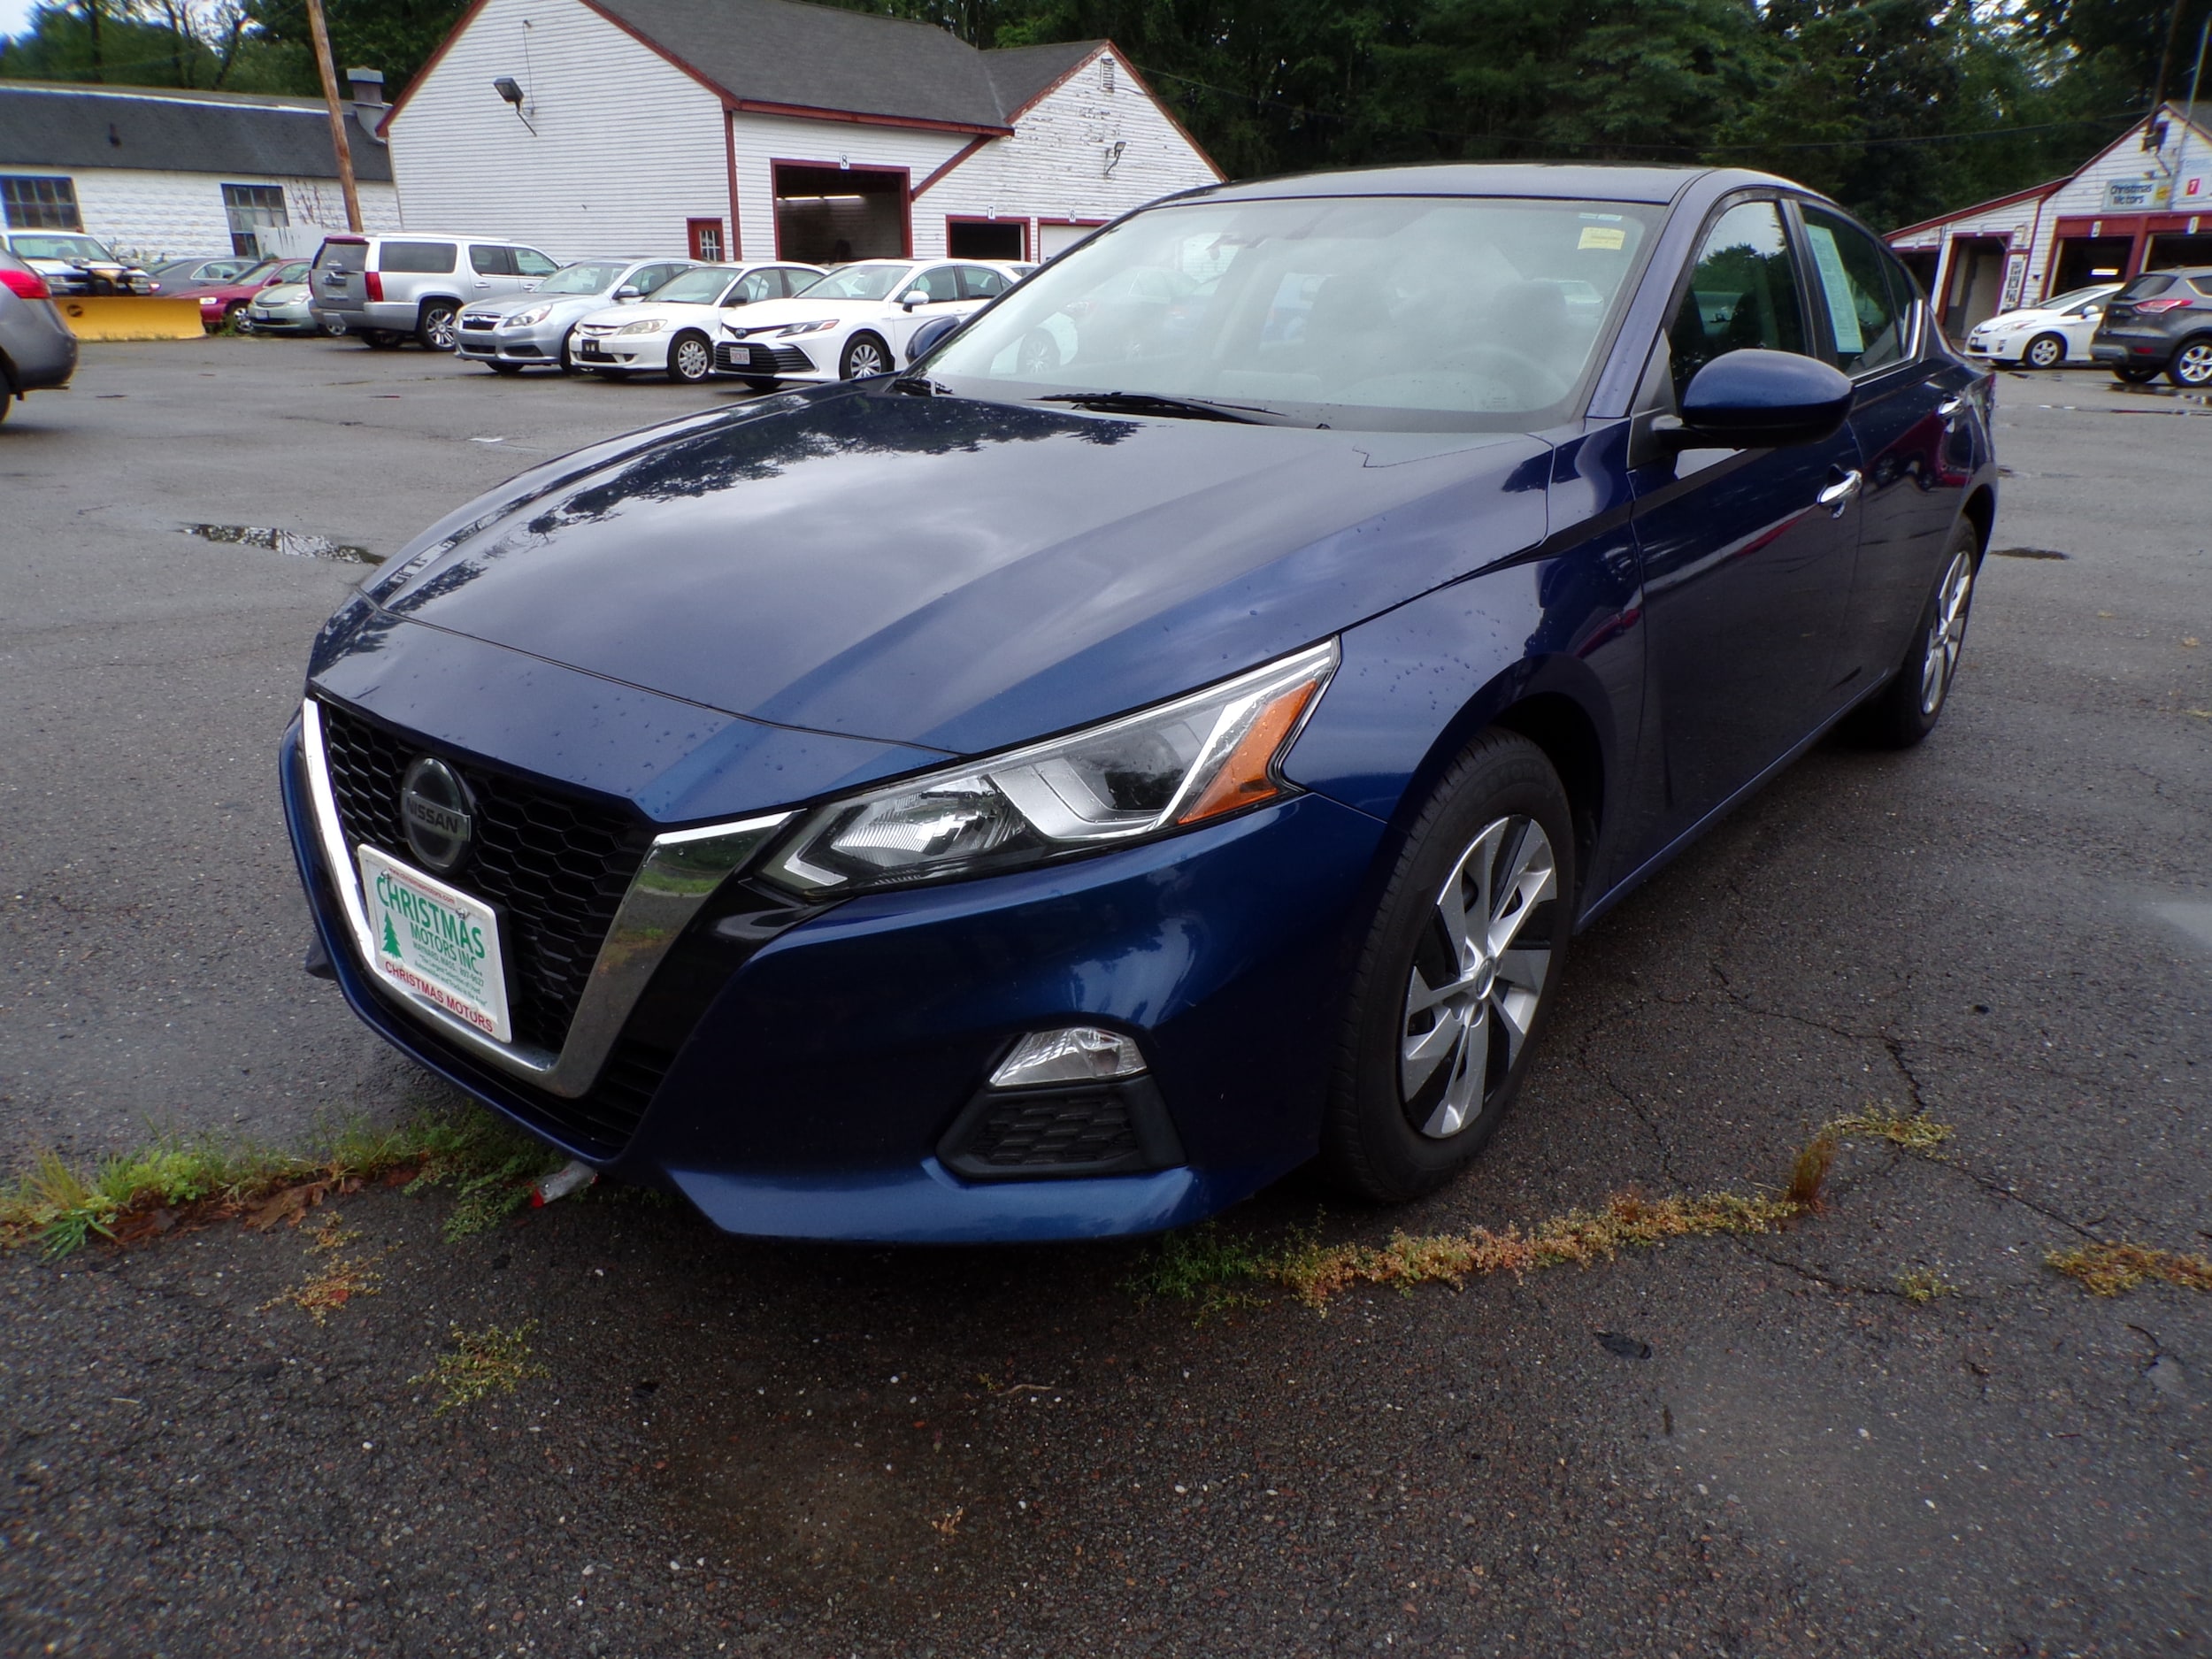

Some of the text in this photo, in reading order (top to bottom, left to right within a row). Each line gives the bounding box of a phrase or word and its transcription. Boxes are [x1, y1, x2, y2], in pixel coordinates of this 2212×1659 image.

[841, 154, 849, 167] 8
[987, 206, 995, 218] 7
[1069, 210, 1075, 220] 6
[406, 795, 458, 834] NISSAN
[375, 875, 485, 959] CHRISTMAS
[410, 922, 483, 975] MOTORS INC.
[385, 961, 493, 1033] CHRISTMAS MOTORS
